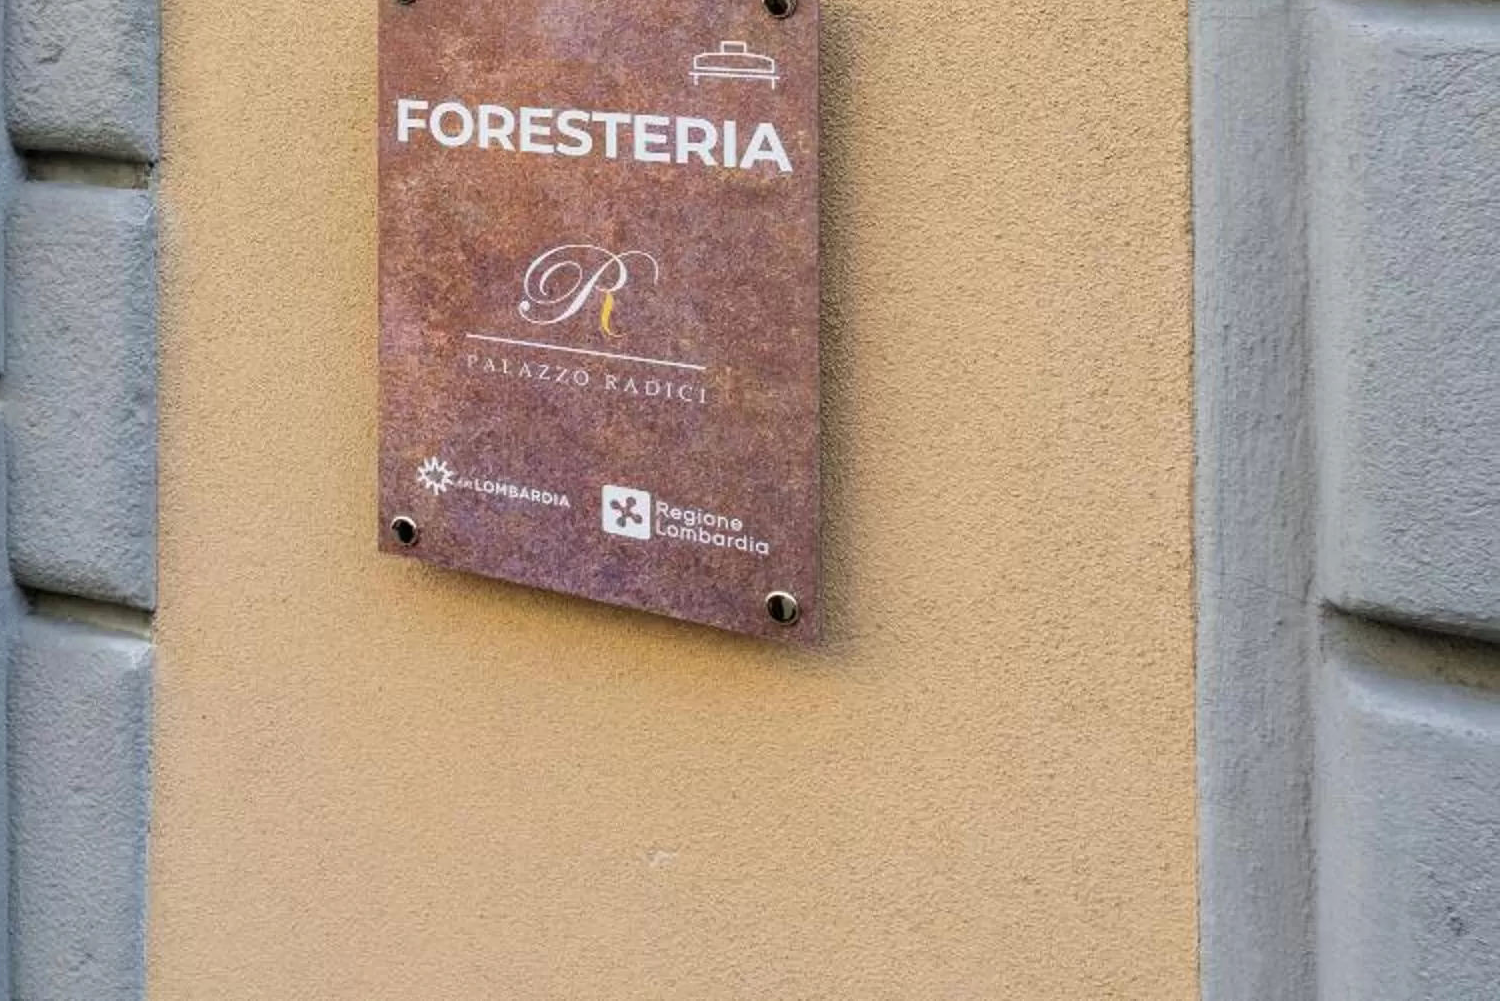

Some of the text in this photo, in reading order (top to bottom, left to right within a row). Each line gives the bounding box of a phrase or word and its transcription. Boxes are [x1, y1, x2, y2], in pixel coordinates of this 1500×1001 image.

[397, 99, 793, 172] FORESTERIA
[466, 354, 707, 403] PALAZZO RADICI
[655, 500, 743, 531] Regione
[655, 518, 769, 555] Lombardia
